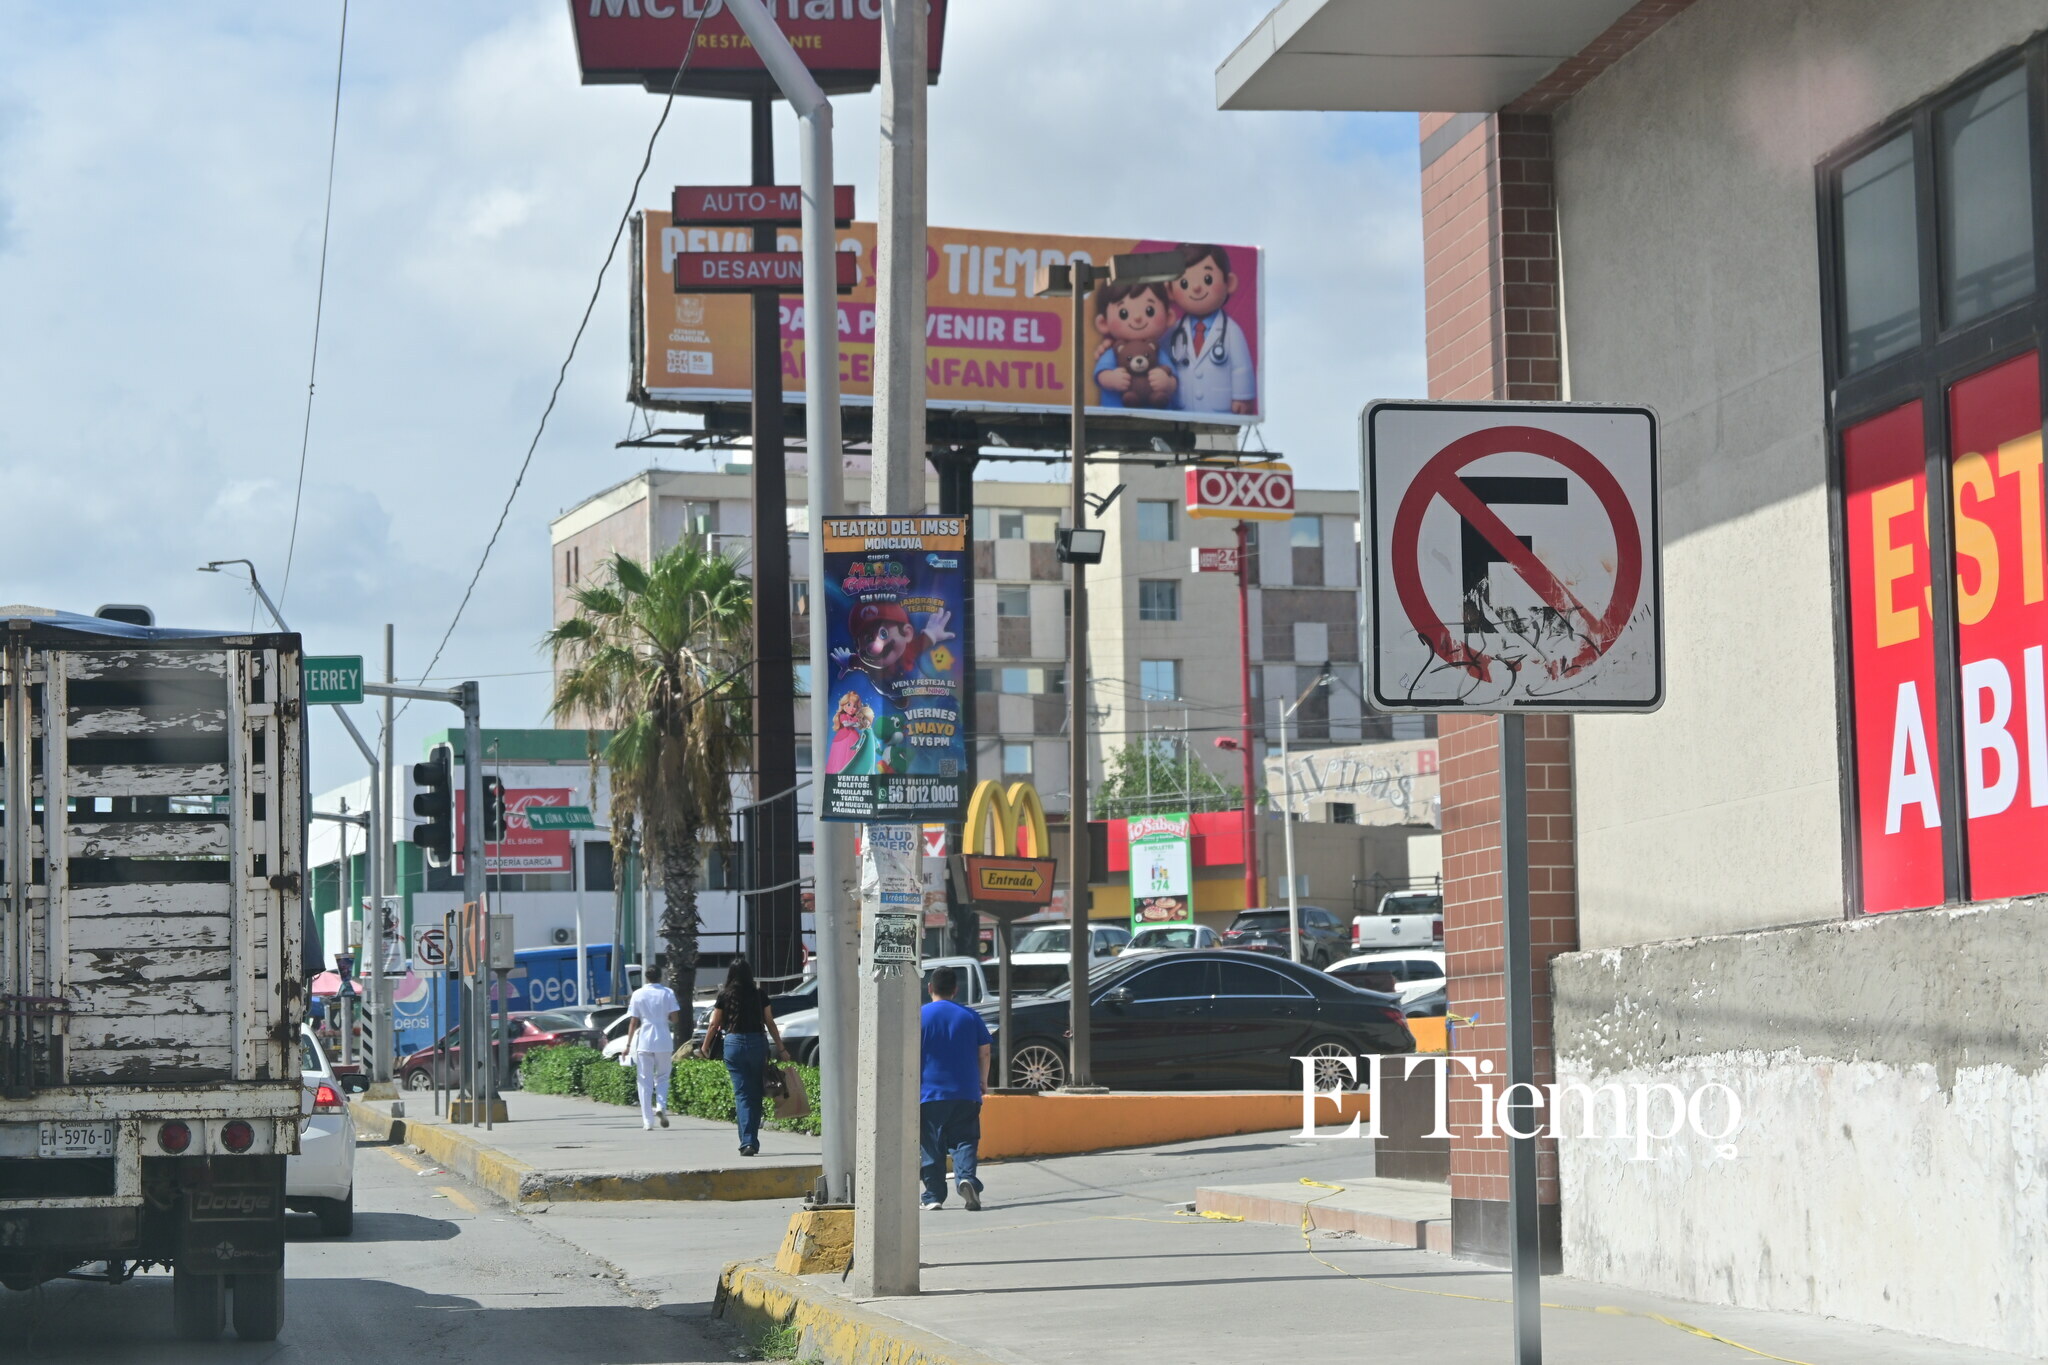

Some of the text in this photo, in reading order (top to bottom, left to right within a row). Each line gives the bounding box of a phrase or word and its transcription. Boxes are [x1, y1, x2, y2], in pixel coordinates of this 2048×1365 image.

[697, 34, 822, 48] RESTANTE
[702, 192, 798, 212] AUTO-M
[702, 260, 803, 279] DESAYUN
[779, 306, 851, 334] PAA
[1013, 317, 1046, 344] EL
[926, 356, 1065, 391] NFANTIL
[1200, 471, 1291, 507] OXXO
[830, 519, 959, 537] TEATRO DEL IMSS
[864, 537, 923, 550] MONCLOVA
[1219, 550, 1237, 564] 24
[848, 561, 903, 576] MARIO
[860, 593, 897, 603] EN VIVO
[304, 668, 358, 690] TERREY
[904, 708, 957, 721] VIERNES
[914, 722, 955, 736] MAYO
[833, 788, 861, 796] TAQUILLA
[888, 785, 959, 803] 56 1012 0001
[870, 831, 912, 841] SALUD
[870, 841, 915, 850] INERO
[523, 857, 552, 866] GARCÍA
[988, 873, 1033, 887] Entrada
[530, 972, 595, 1010] pepi
[197, 1191, 270, 1213] Dodge
